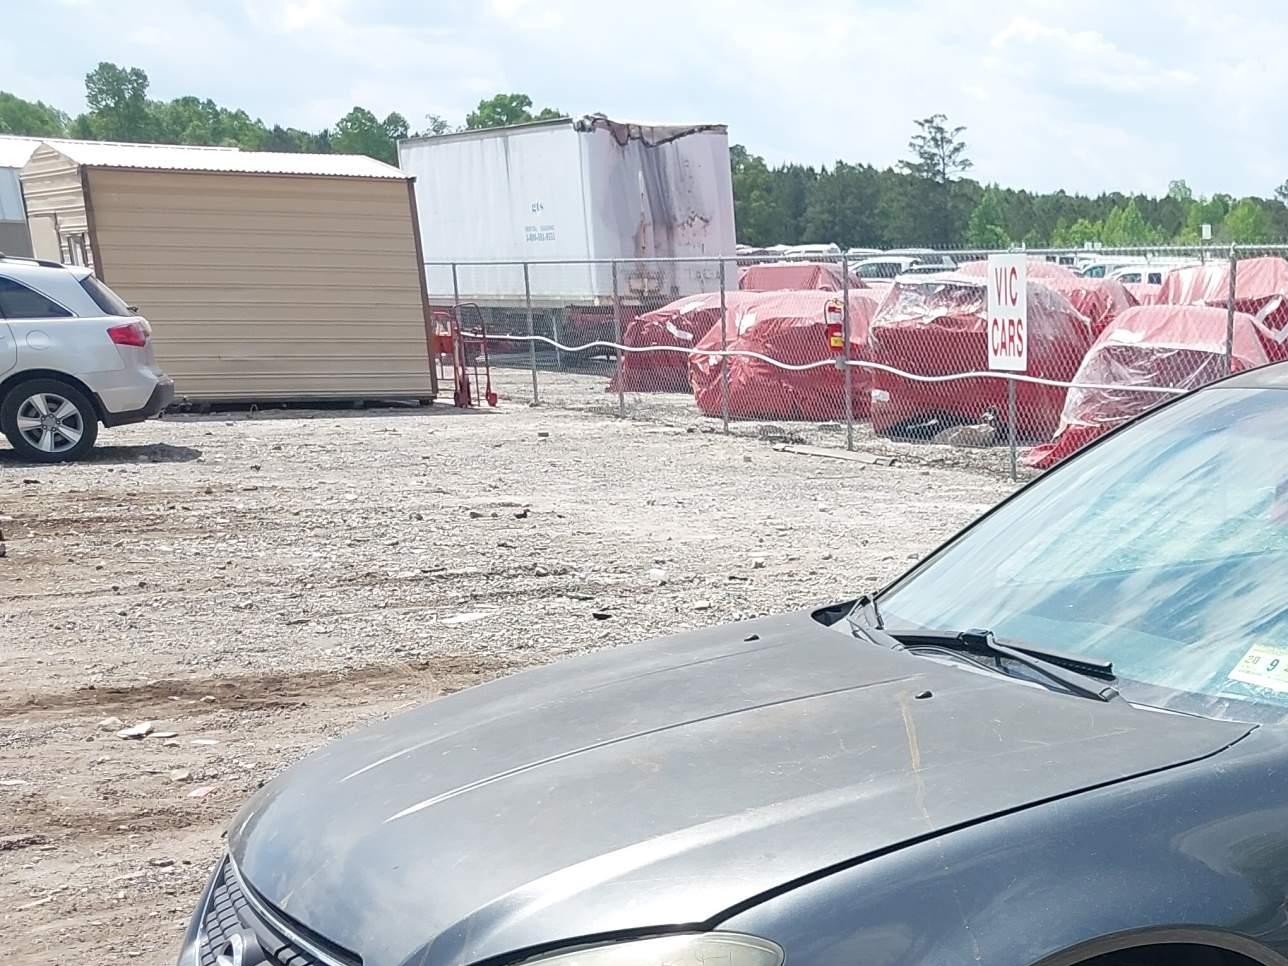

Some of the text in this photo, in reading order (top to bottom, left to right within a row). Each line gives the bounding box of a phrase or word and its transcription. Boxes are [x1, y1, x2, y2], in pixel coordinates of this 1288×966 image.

[995, 266, 1017, 306] VIC
[991, 317, 1024, 358] CARS
[1266, 658, 1280, 672] 9
